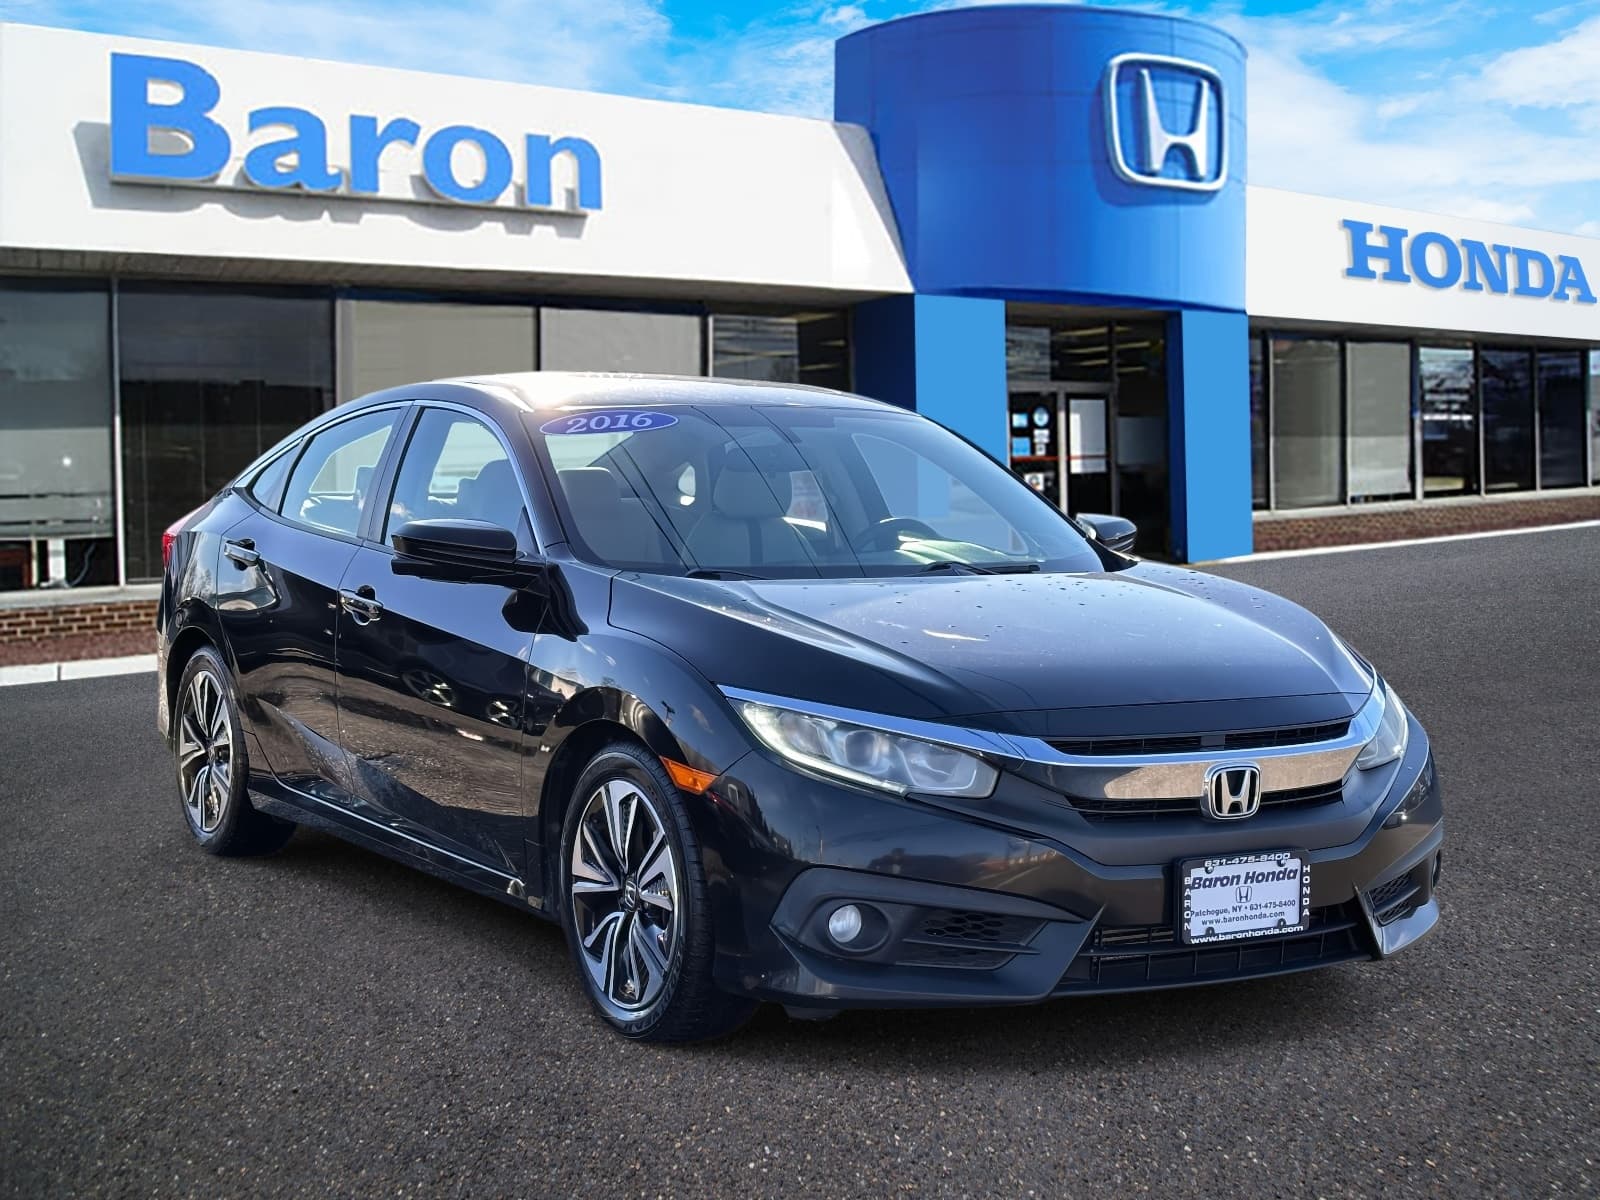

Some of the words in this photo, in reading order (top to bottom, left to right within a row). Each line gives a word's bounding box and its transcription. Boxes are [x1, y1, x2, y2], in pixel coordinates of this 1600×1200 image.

[110, 52, 603, 211] Baron
[1342, 219, 1597, 304] HONDA
[566, 413, 653, 434] 2016
[1204, 852, 1291, 867] 631-475-8400
[1191, 874, 1241, 889] Baron
[1244, 867, 1298, 884] Honda
[1201, 911, 1285, 925] www.baronhonda.com
[1191, 925, 1304, 944] www.baronhonda.com
